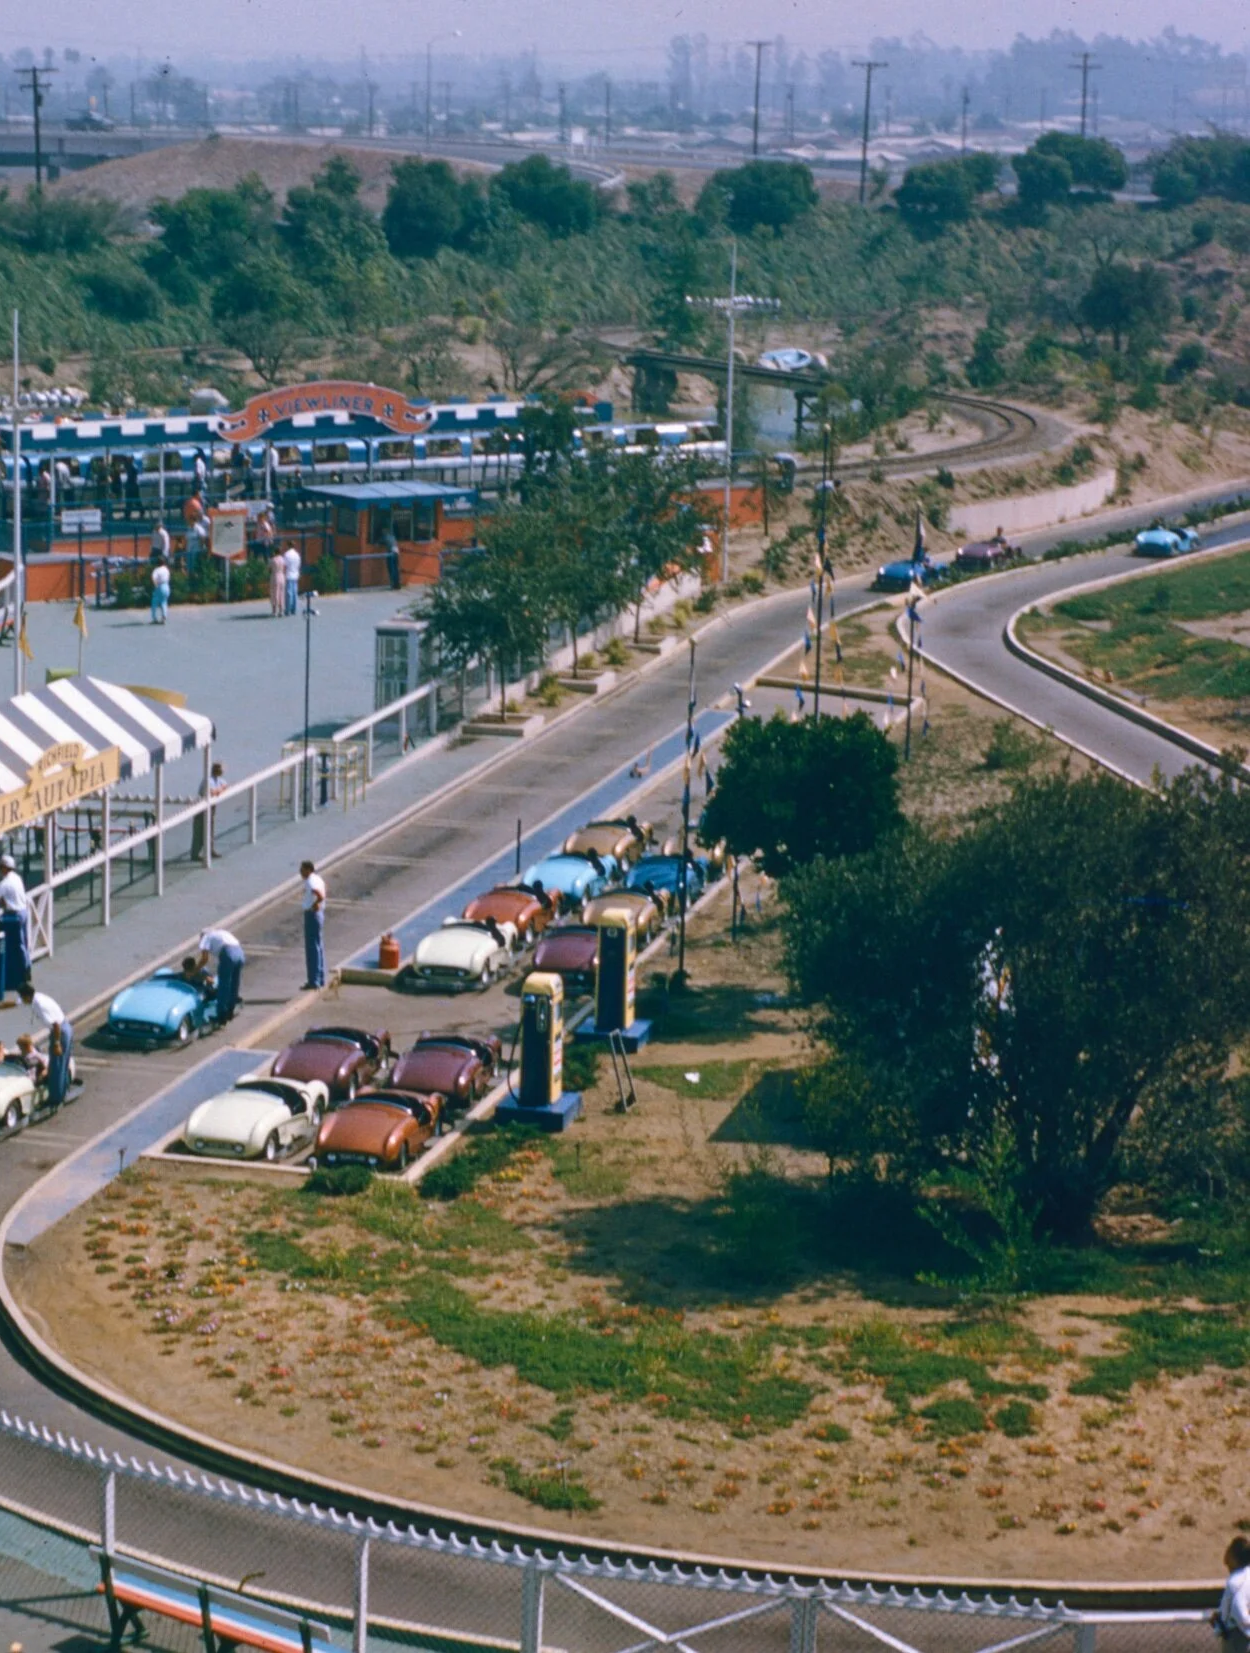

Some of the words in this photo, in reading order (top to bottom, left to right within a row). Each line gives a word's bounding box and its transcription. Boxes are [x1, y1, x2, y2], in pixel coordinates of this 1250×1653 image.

[273, 394, 374, 416] VIEWLINER
[37, 743, 80, 773] RICHFIELD
[32, 761, 106, 812] AUTOPIA
